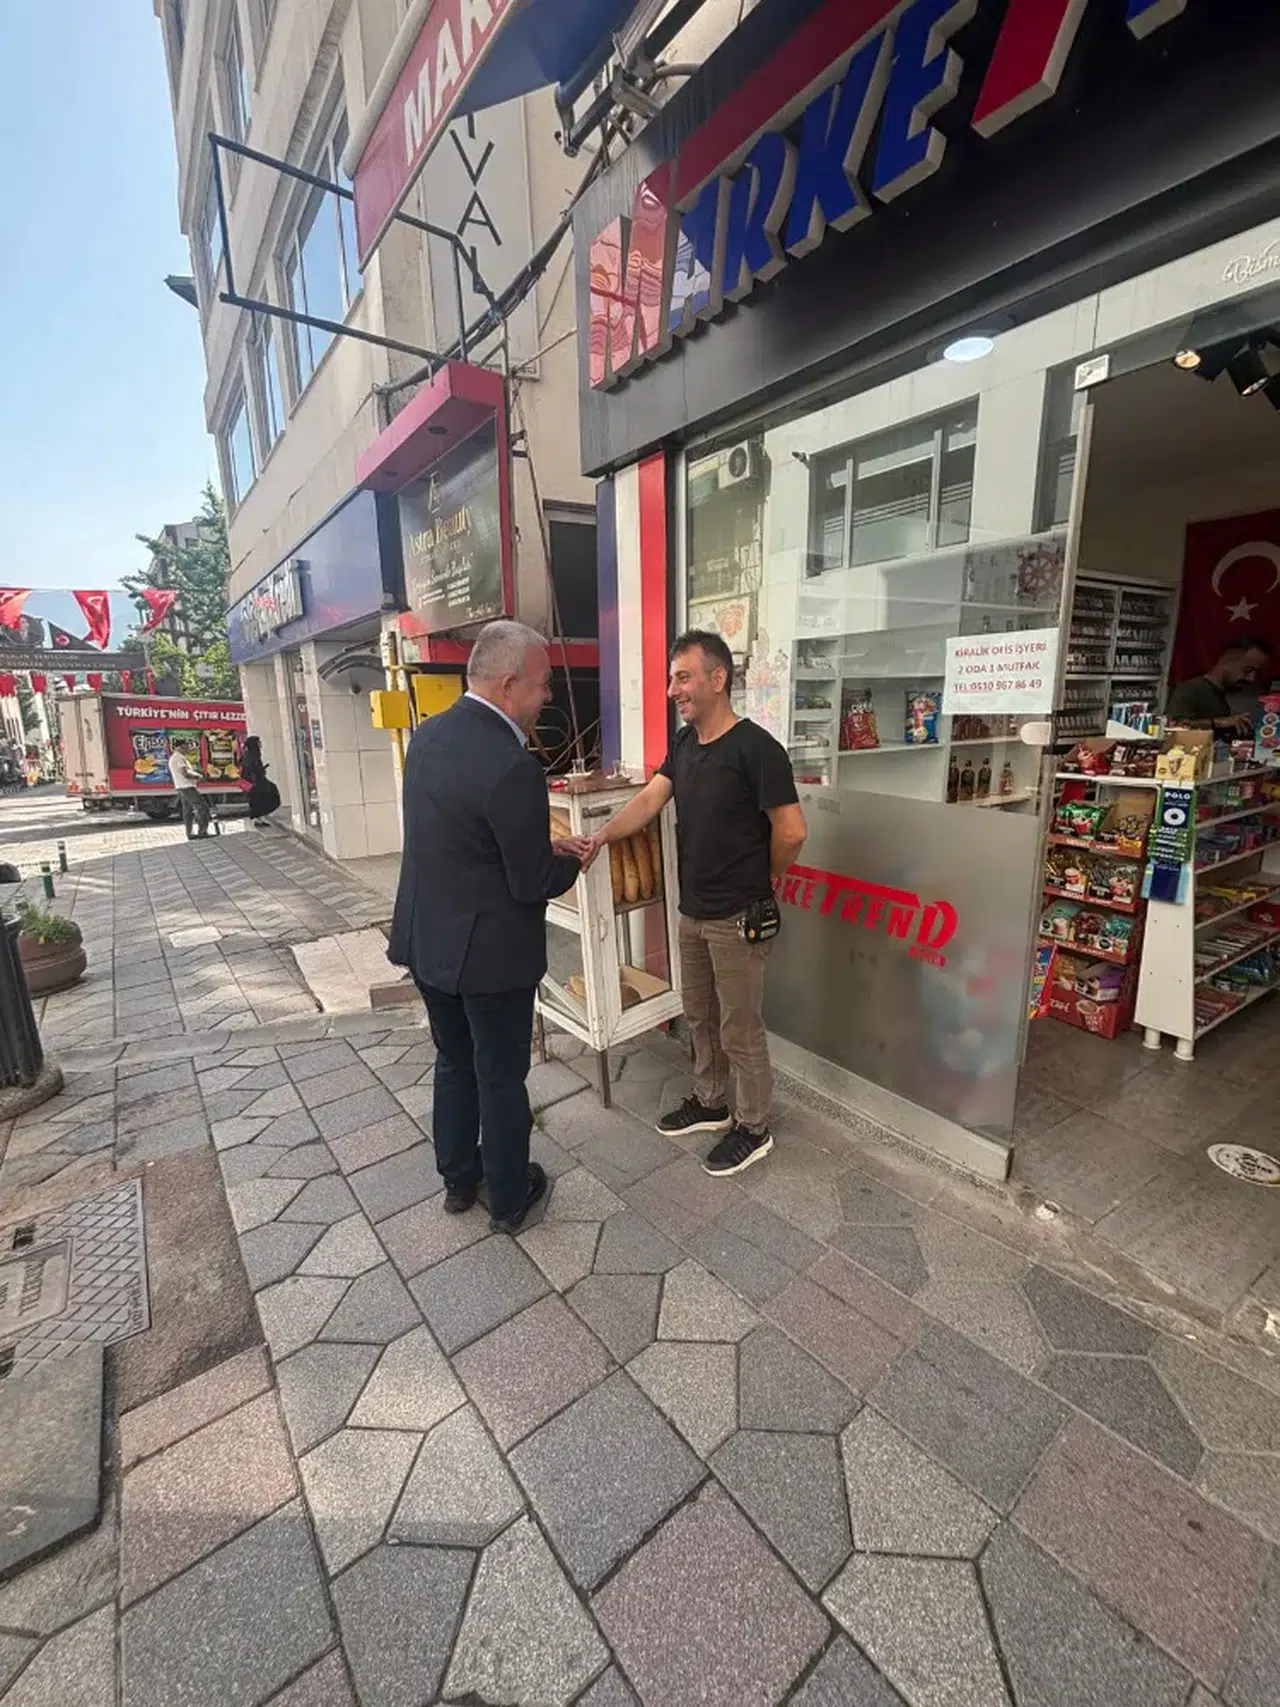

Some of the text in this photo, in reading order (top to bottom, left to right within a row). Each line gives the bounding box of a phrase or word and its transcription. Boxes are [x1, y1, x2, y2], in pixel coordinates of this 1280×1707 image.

[965, 664, 987, 674] ODA
[996, 661, 1040, 673] MUTFAK
[1165, 791, 1191, 800] POLO
